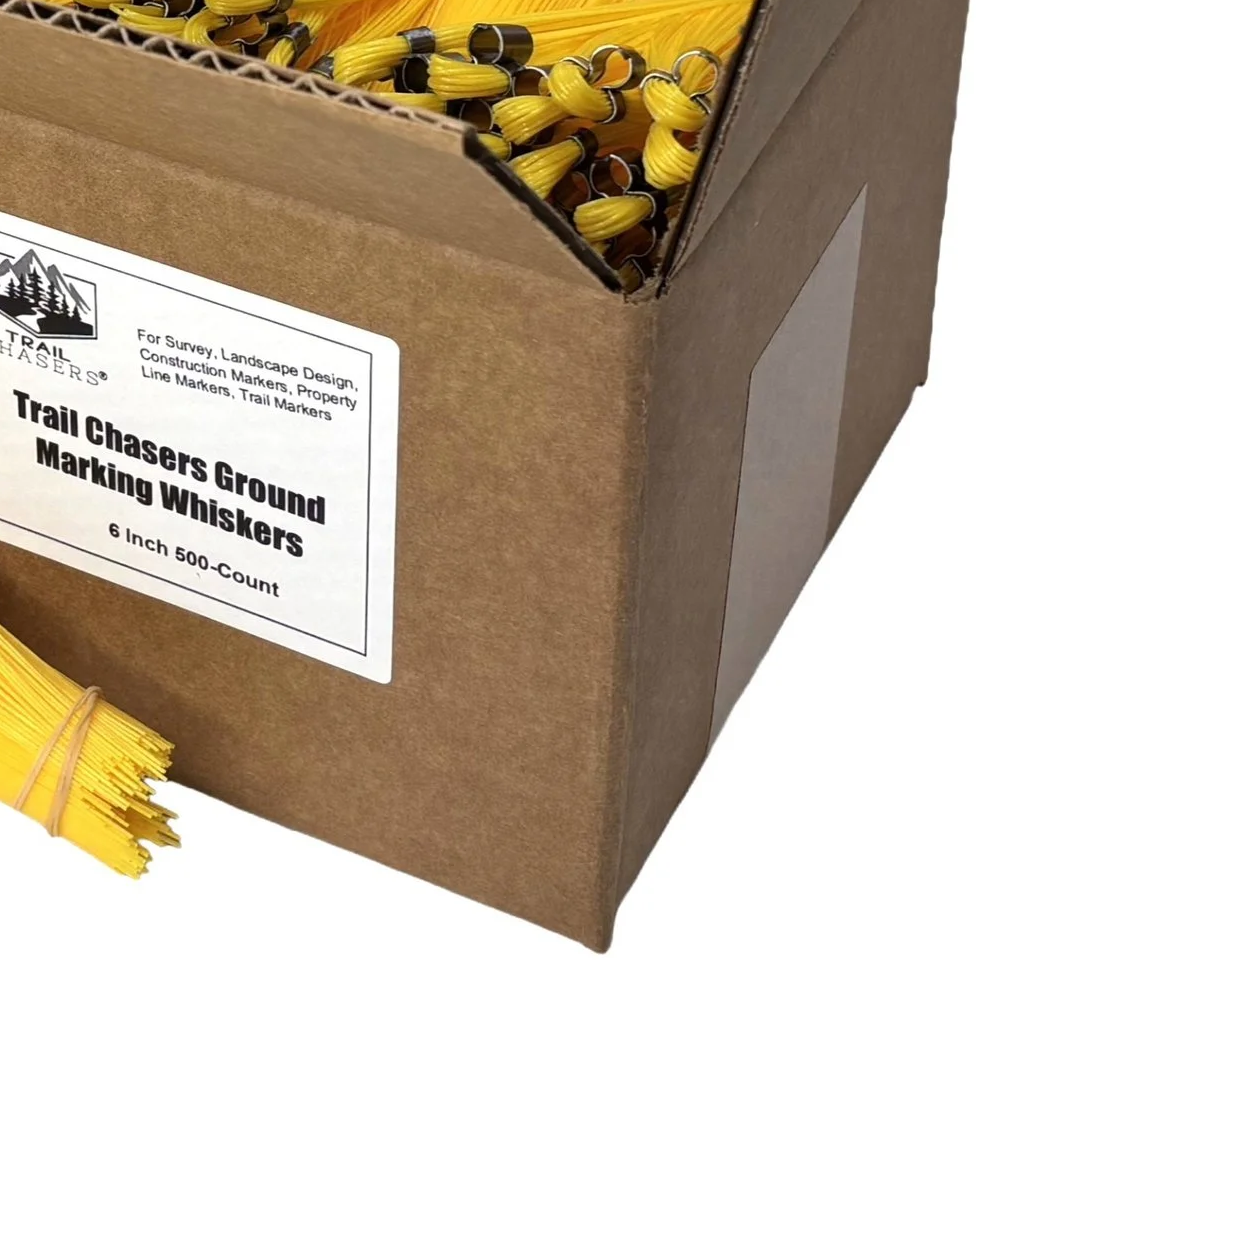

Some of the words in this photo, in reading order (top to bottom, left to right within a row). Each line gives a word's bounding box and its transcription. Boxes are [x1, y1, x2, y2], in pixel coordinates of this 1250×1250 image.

[5, 329, 71, 362] TRAIL
[137, 329, 160, 345] For
[165, 335, 217, 360] Survey,
[221, 347, 299, 377] Landscape
[303, 367, 358, 392] Design,
[139, 348, 227, 379] Construction
[231, 369, 292, 395] Markers,
[297, 385, 357, 411] Property
[141, 365, 171, 382] Line
[175, 373, 235, 399] Markers,
[239, 388, 270, 406] Trail
[274, 397, 332, 421] Markers
[13, 389, 79, 437] Trail
[85, 416, 208, 483] Chasers
[214, 461, 326, 526] Ground
[36, 437, 153, 506] Marking
[159, 481, 304, 558] Whiskers
[109, 523, 120, 538] 6
[126, 528, 168, 556] Inch
[175, 546, 280, 597] 500-Count
